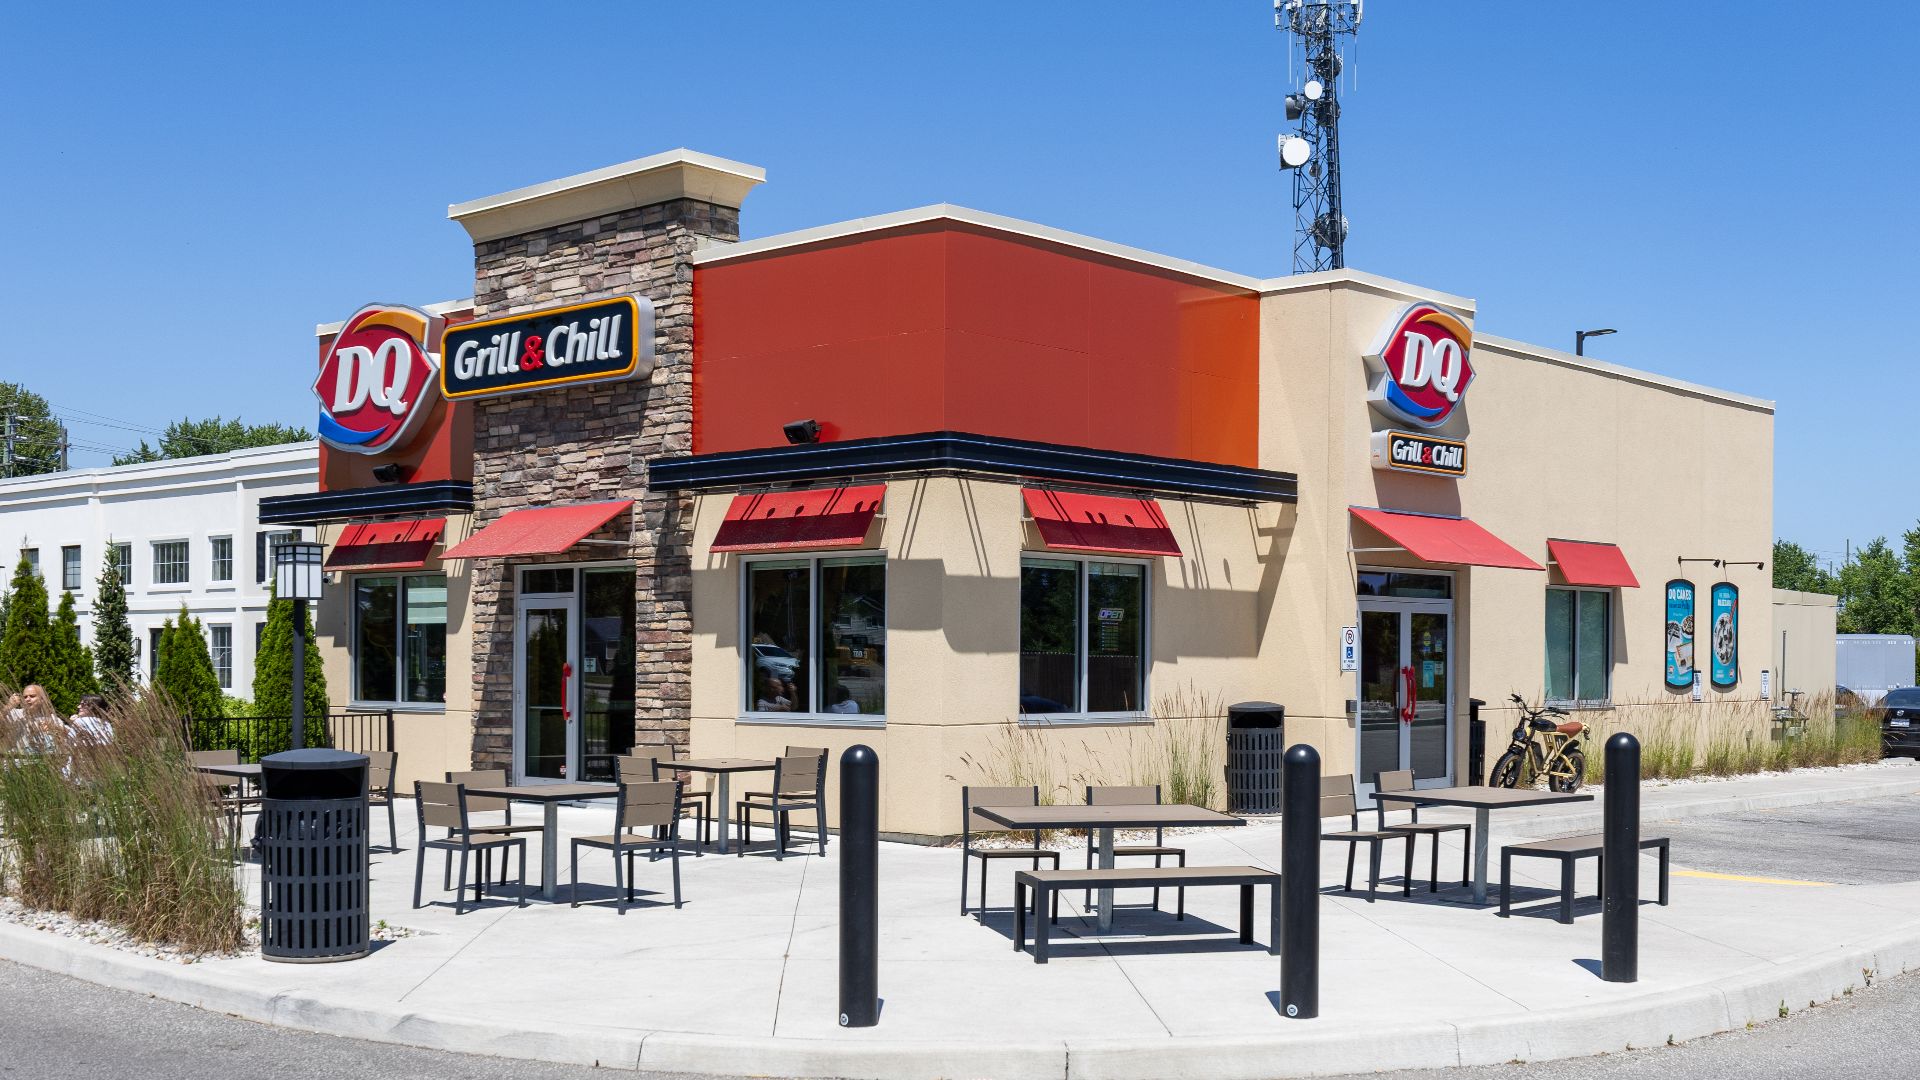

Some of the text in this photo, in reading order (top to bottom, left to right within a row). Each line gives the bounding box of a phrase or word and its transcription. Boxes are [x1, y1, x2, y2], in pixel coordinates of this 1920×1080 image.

[332, 337, 412, 416] DQ
[1400, 330, 1462, 402] DQ
[1100, 609, 1123, 619] OPEN
